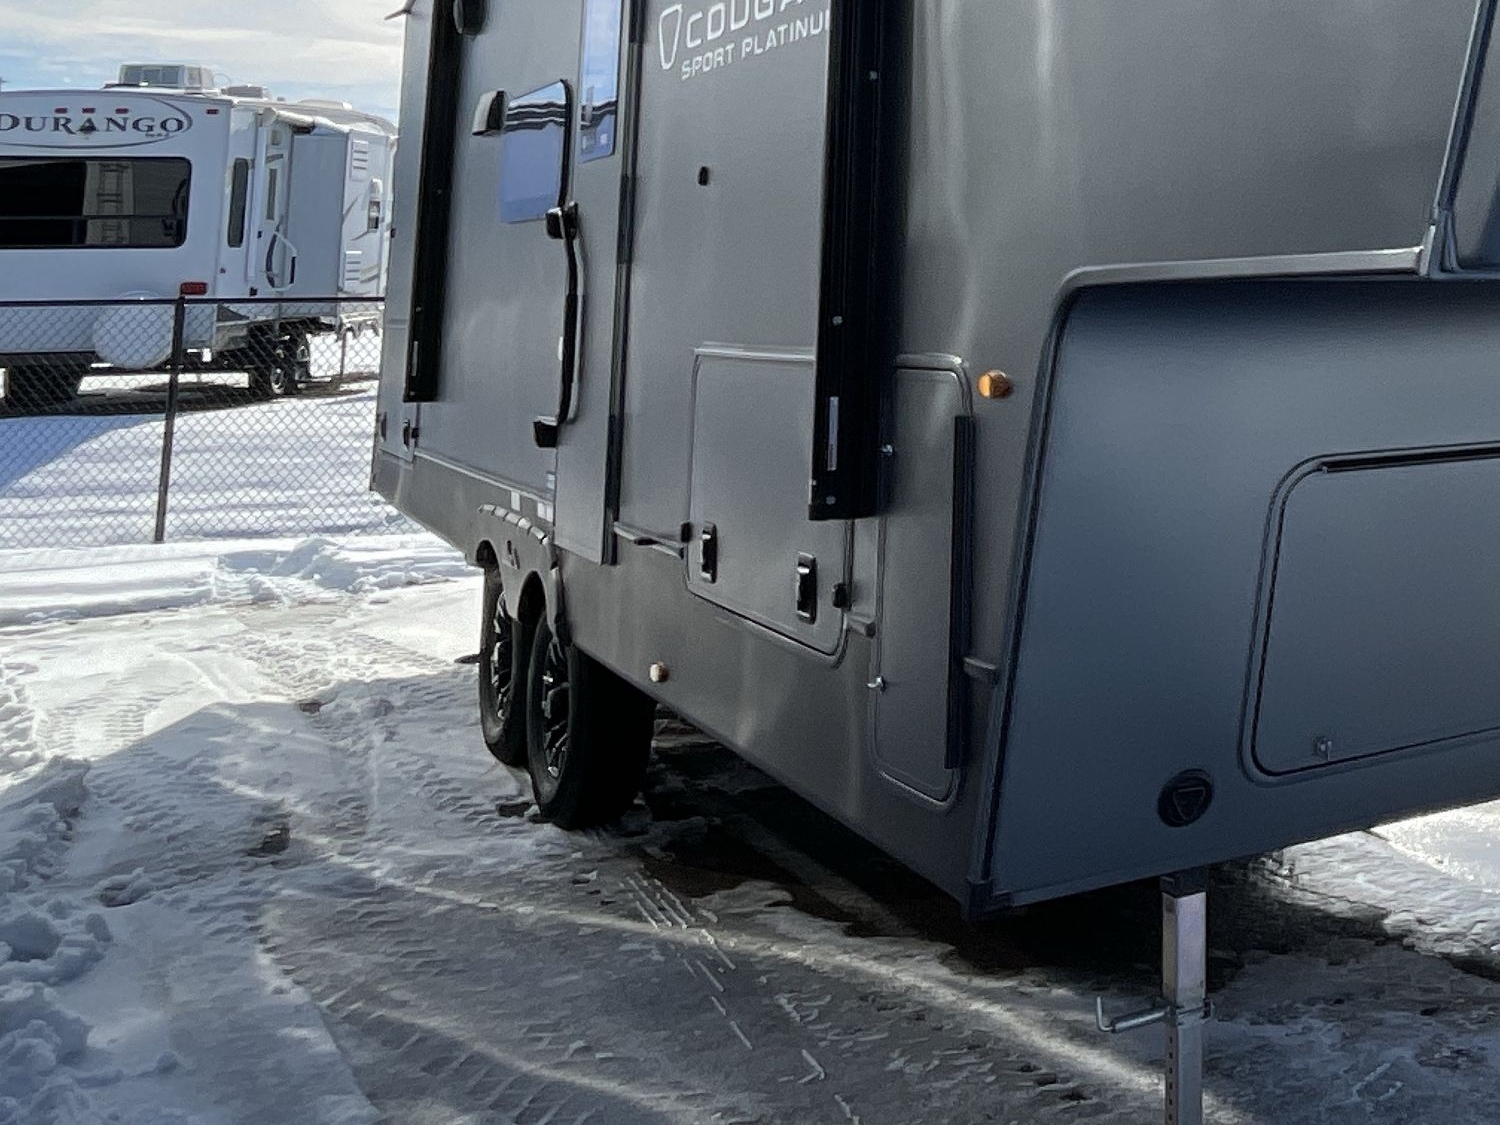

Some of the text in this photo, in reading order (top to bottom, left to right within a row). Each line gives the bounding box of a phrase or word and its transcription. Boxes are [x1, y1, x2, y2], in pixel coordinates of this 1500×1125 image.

[681, 9, 830, 80] SPORT PLATINU
[0, 113, 184, 135] DURANGO
